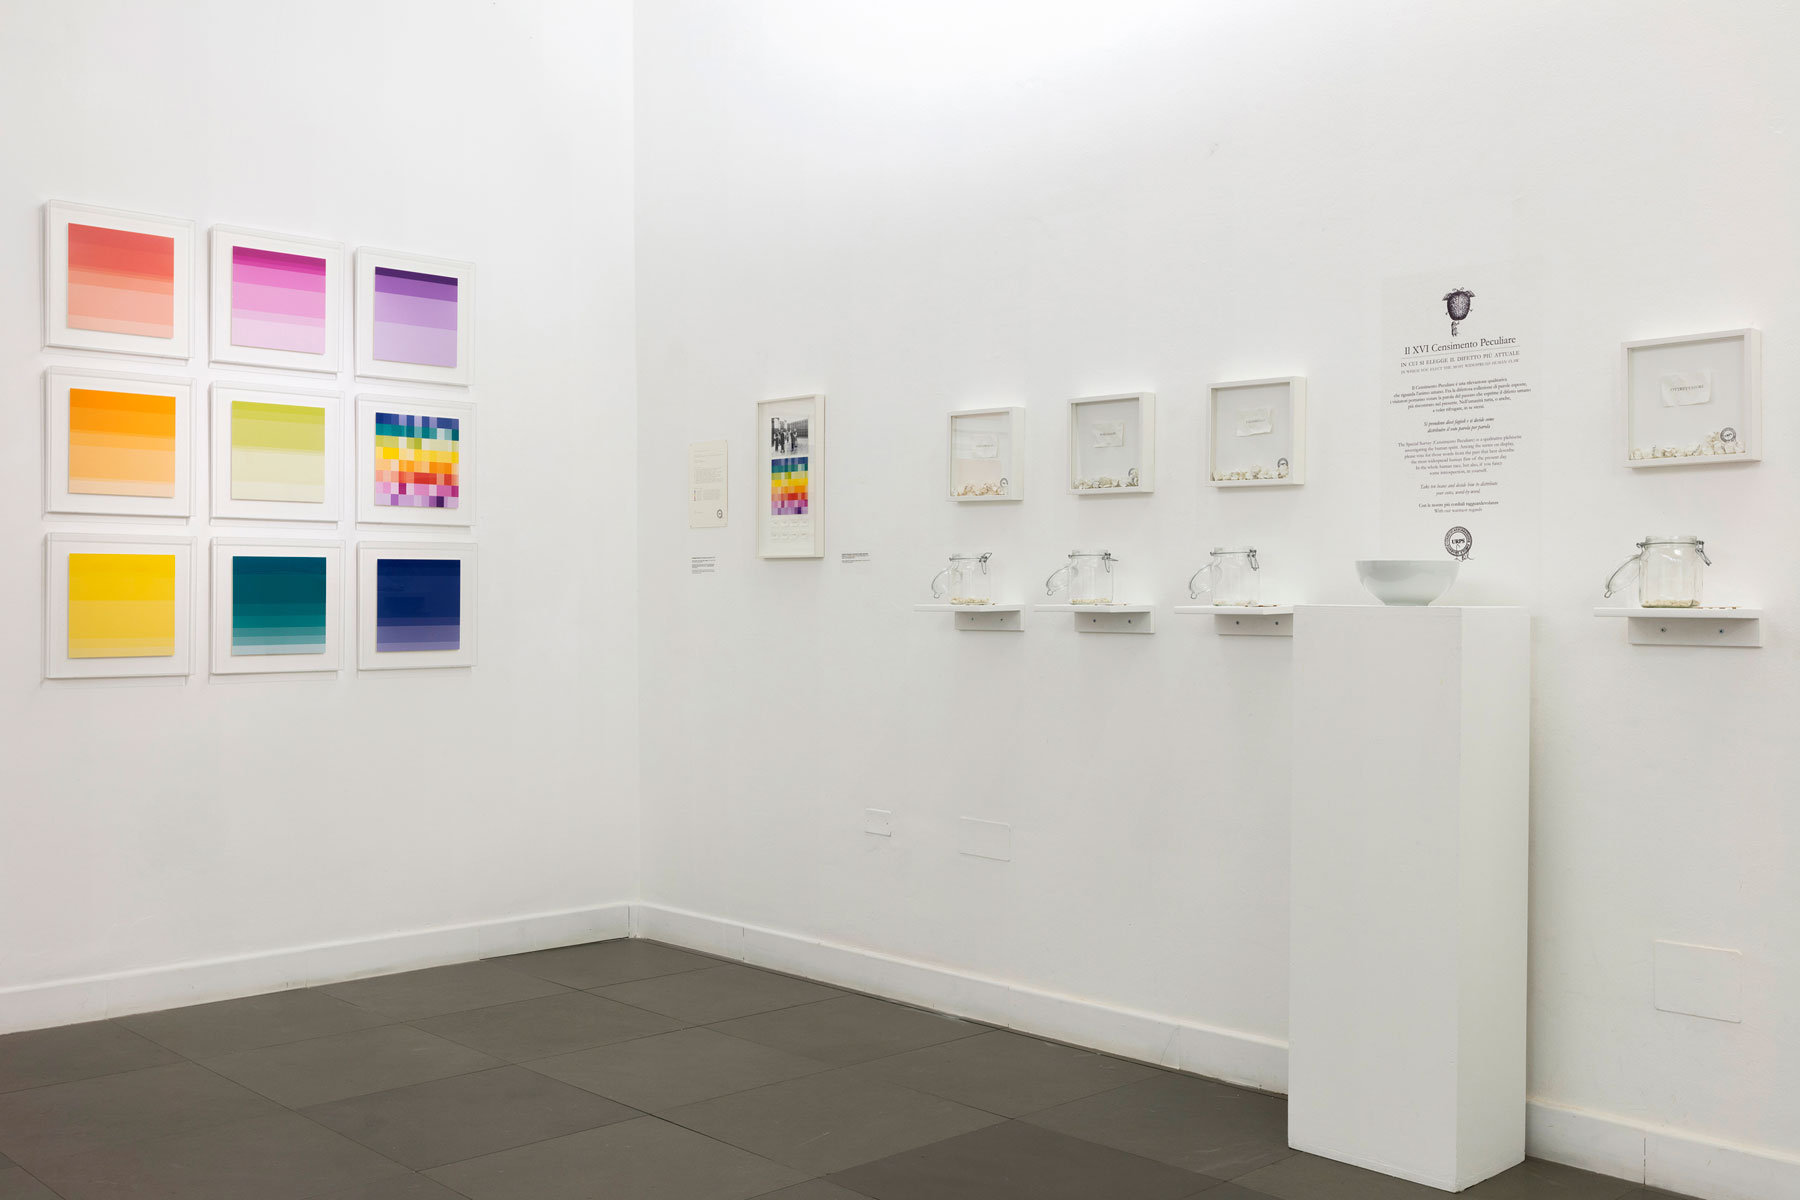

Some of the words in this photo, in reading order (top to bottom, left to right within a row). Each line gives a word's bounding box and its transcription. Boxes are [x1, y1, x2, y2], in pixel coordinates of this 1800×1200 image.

[1404, 345, 1410, 355] Il
[1412, 343, 1429, 354] XVI
[1431, 340, 1478, 352] Censimento
[1480, 335, 1516, 347] Peculiare
